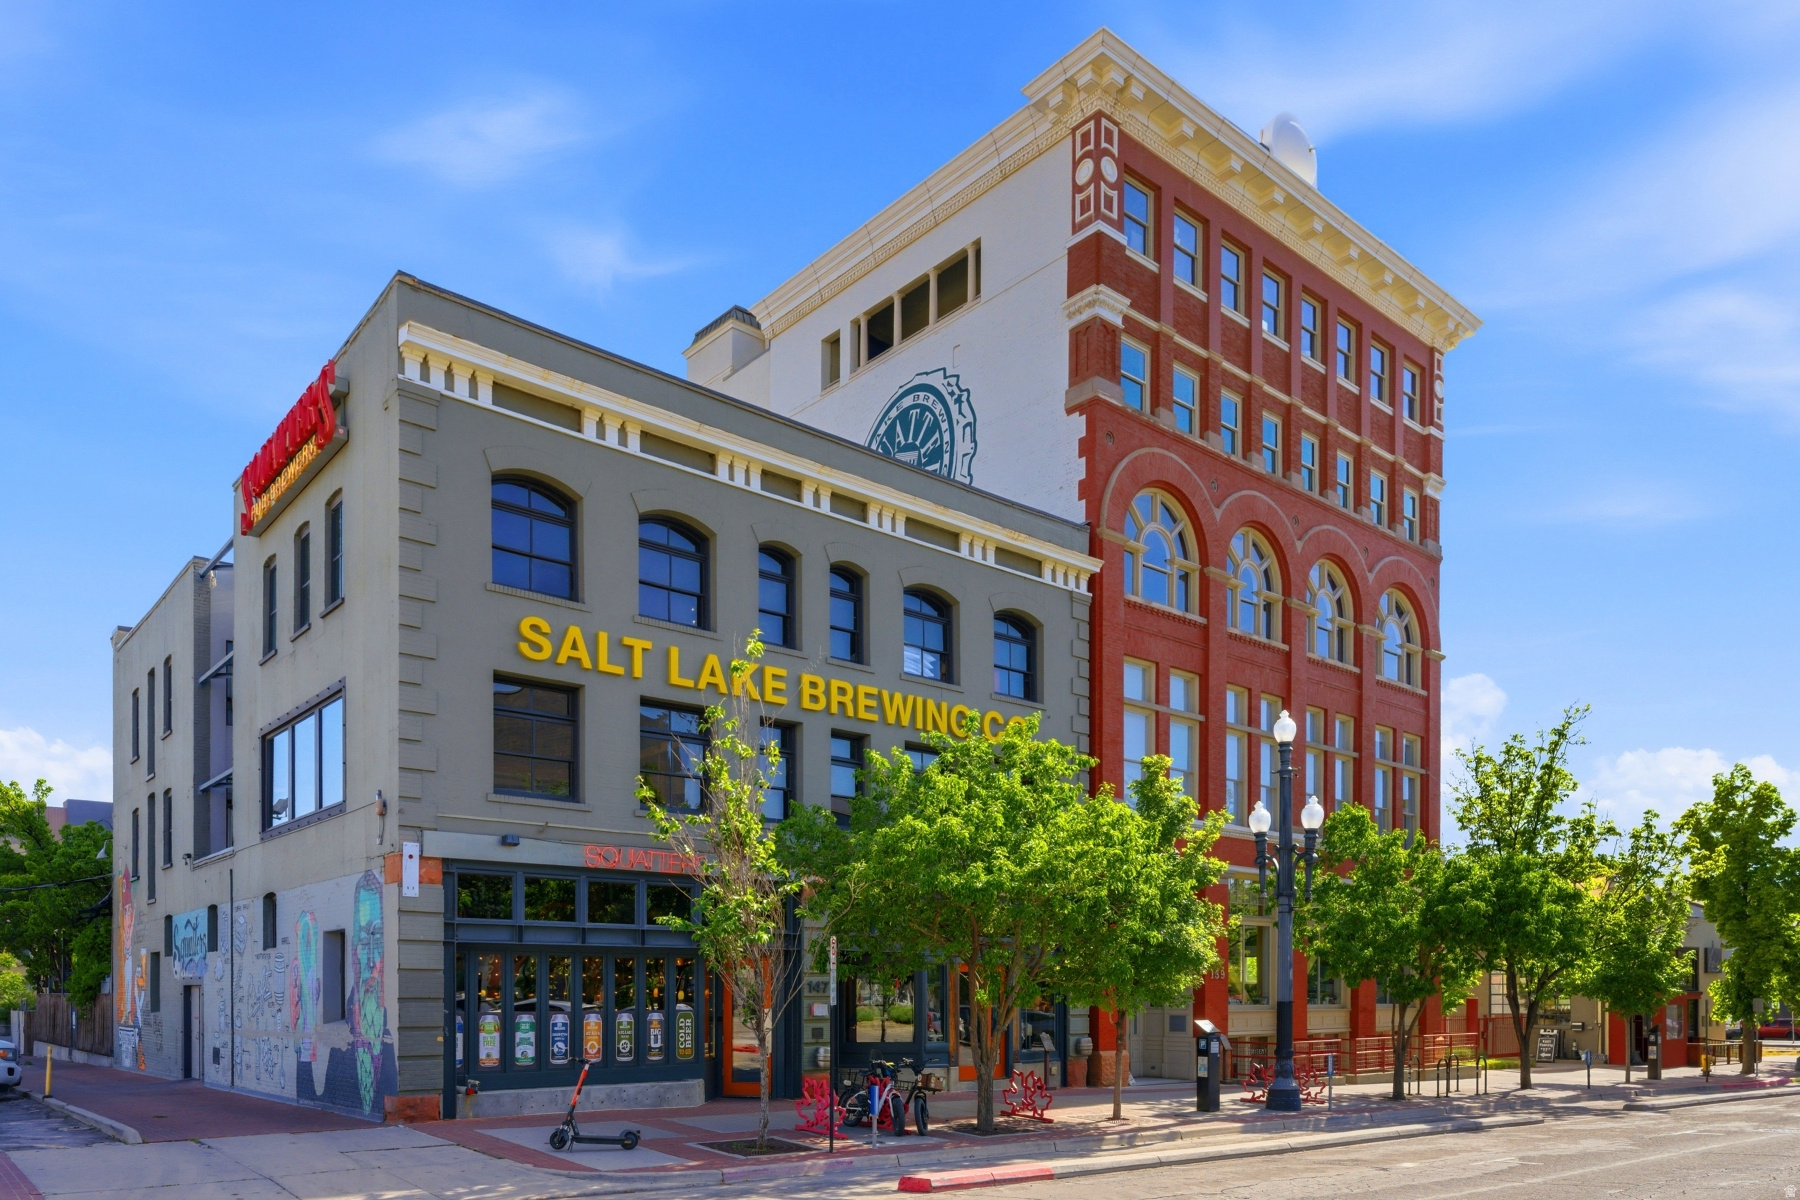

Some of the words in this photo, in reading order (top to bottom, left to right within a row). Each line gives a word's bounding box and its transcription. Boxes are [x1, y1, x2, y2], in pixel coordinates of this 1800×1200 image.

[875, 401, 904, 444] AKE
[270, 435, 317, 502] BREWERY
[517, 616, 653, 679] SALT
[668, 645, 788, 705] LAKE
[799, 672, 971, 738] BREWING
[982, 710, 1028, 744] C
[807, 981, 829, 993] 147
